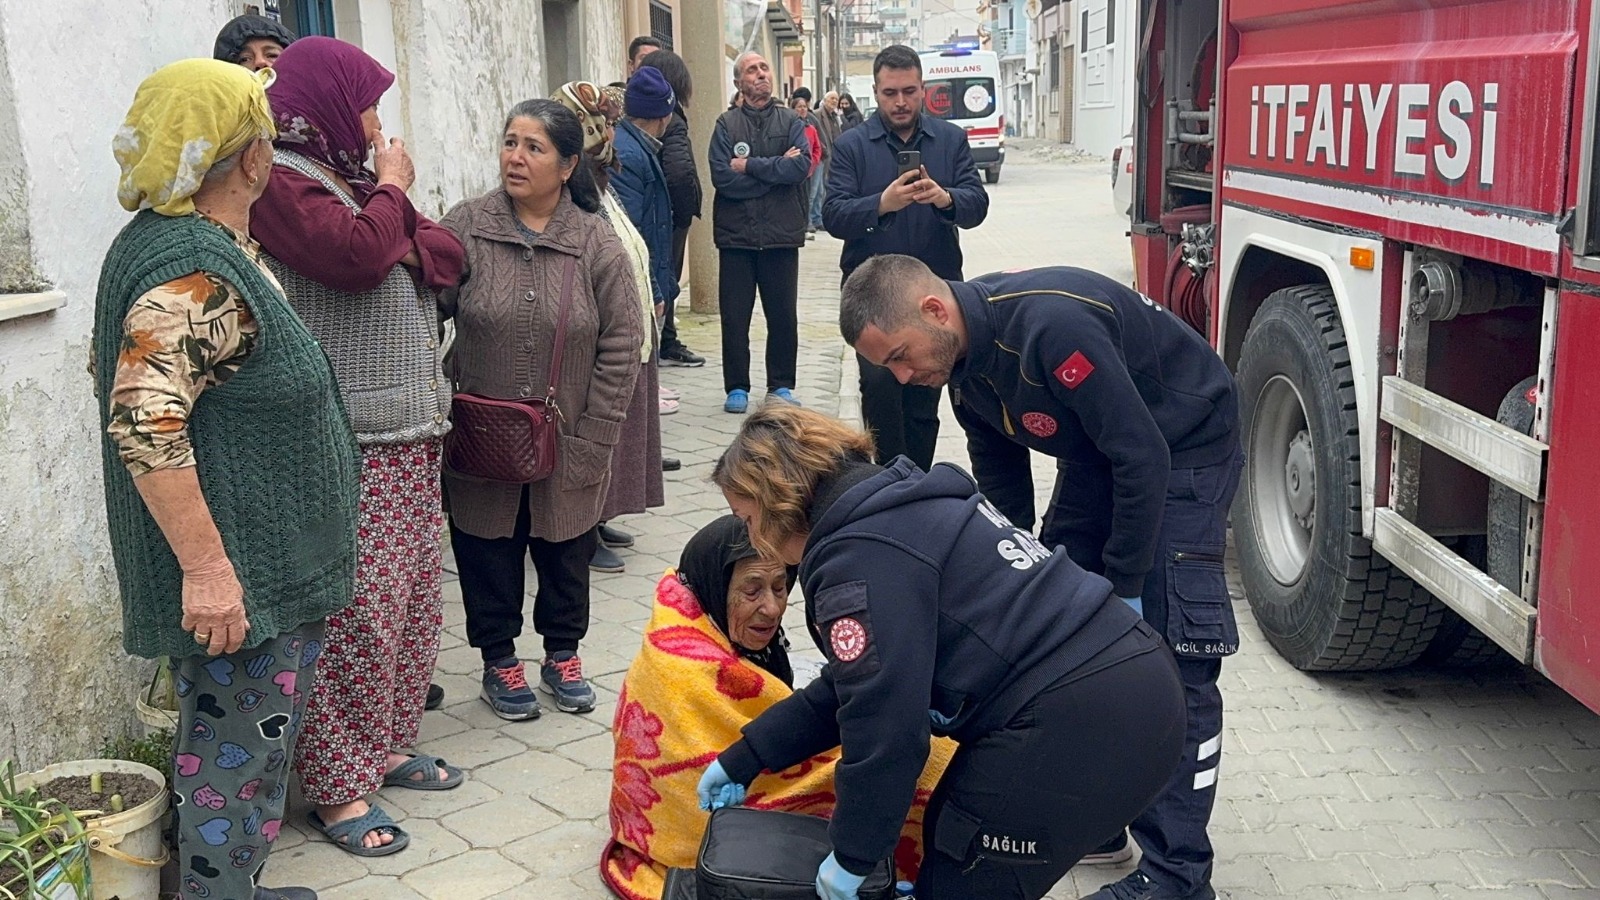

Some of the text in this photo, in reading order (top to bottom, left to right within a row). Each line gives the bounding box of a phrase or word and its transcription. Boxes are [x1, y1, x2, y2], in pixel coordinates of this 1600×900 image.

[929, 65, 982, 75] AMBULANS
[1250, 80, 1498, 186] İTFAİYESİ
[1205, 643, 1237, 653] SAĞLIK
[982, 834, 1037, 854] SAĞLIK
